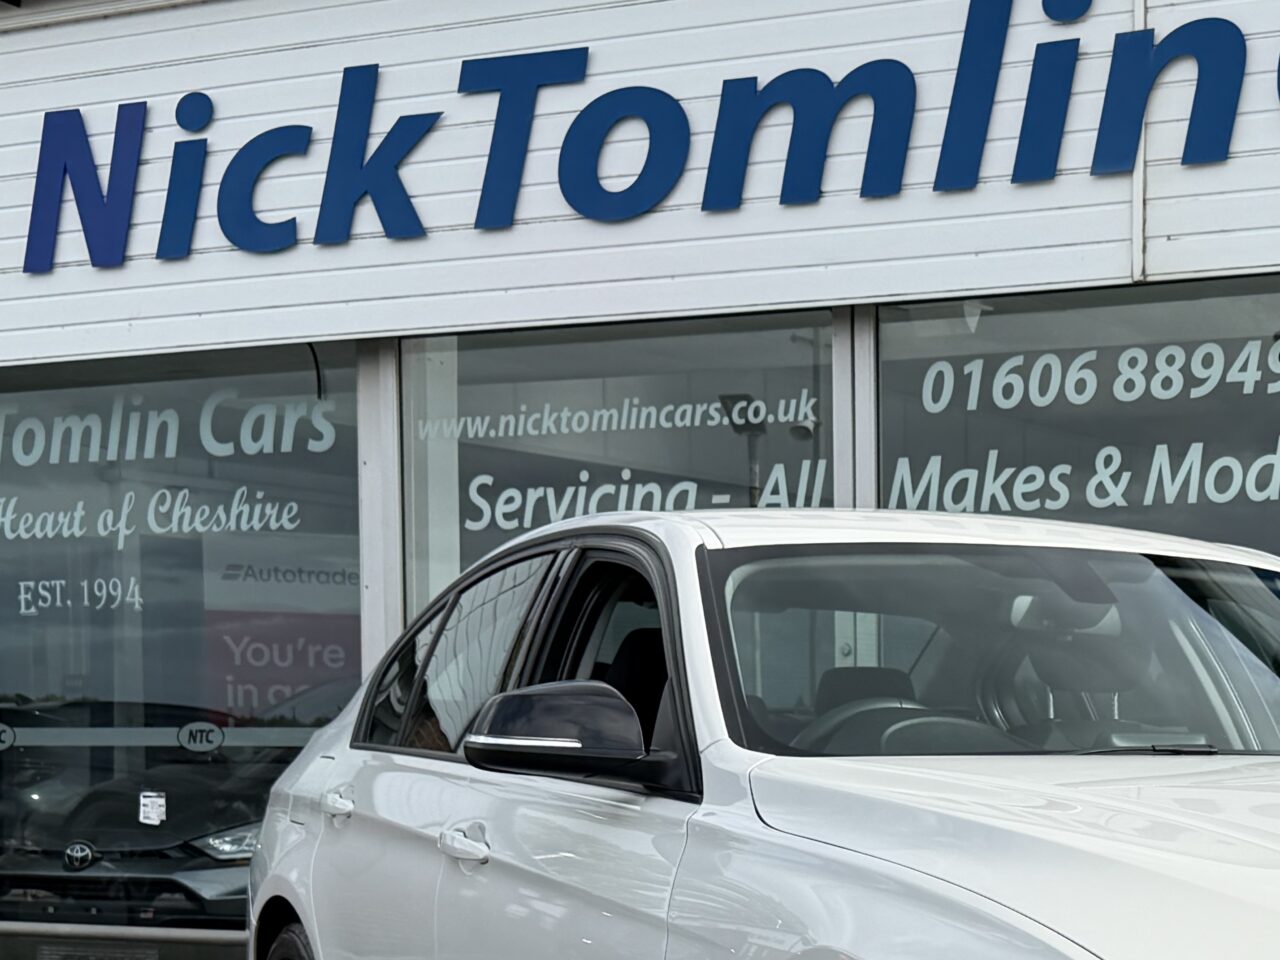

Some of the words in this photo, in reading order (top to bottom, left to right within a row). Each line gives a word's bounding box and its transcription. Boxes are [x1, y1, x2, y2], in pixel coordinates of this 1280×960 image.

[921, 350, 1098, 414] 01606
[199, 388, 337, 457] Cars
[417, 389, 818, 441] www.nicktomlincars.co.uk
[756, 459, 828, 509] All
[889, 449, 1072, 513] Makes
[1085, 445, 1132, 508] &
[97, 491, 136, 551] of
[146, 486, 301, 535] Cheshire
[18, 580, 72, 616] EST.
[80, 576, 143, 611] 1994
[187, 729, 215, 745] NTC
